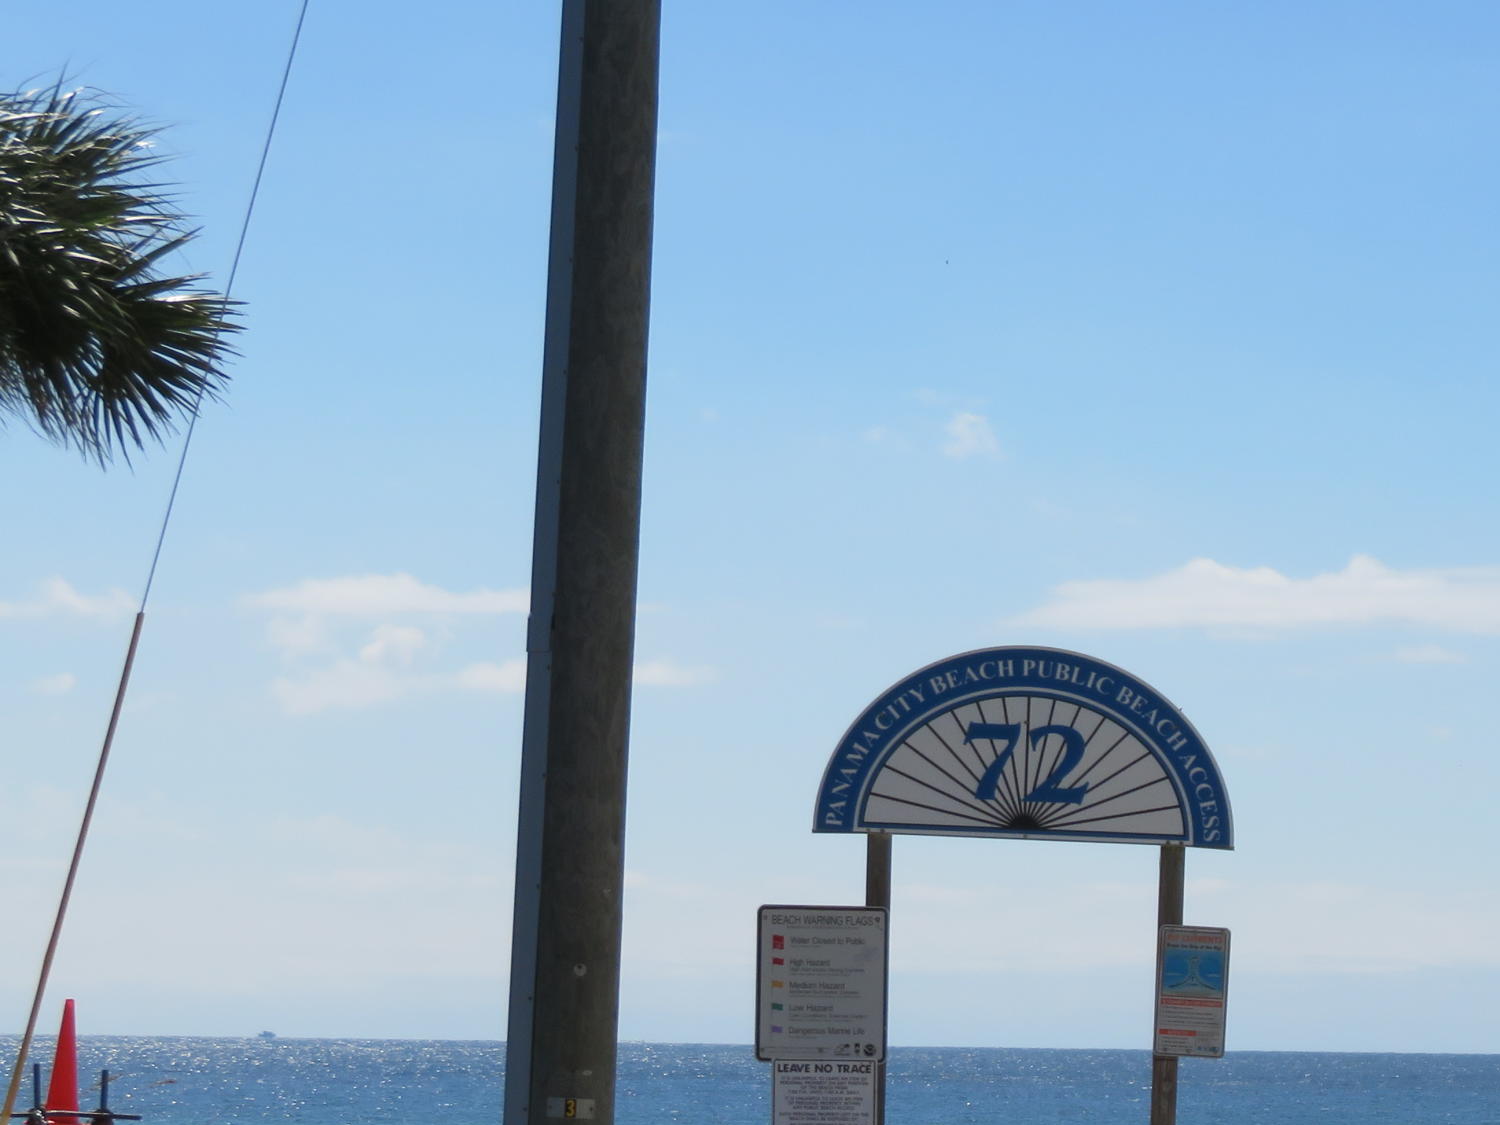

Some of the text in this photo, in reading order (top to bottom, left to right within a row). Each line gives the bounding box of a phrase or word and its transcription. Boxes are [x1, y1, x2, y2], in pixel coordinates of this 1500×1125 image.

[826, 659, 1220, 842] PANAMA CITY BEACH PUBLIC BEACH ACCESS
[963, 722, 1090, 805] 72
[771, 914, 874, 927] BEACH WARNING FLAGS
[777, 1063, 872, 1075] LEAVE NO TRACE
[566, 1100, 575, 1117] 3
